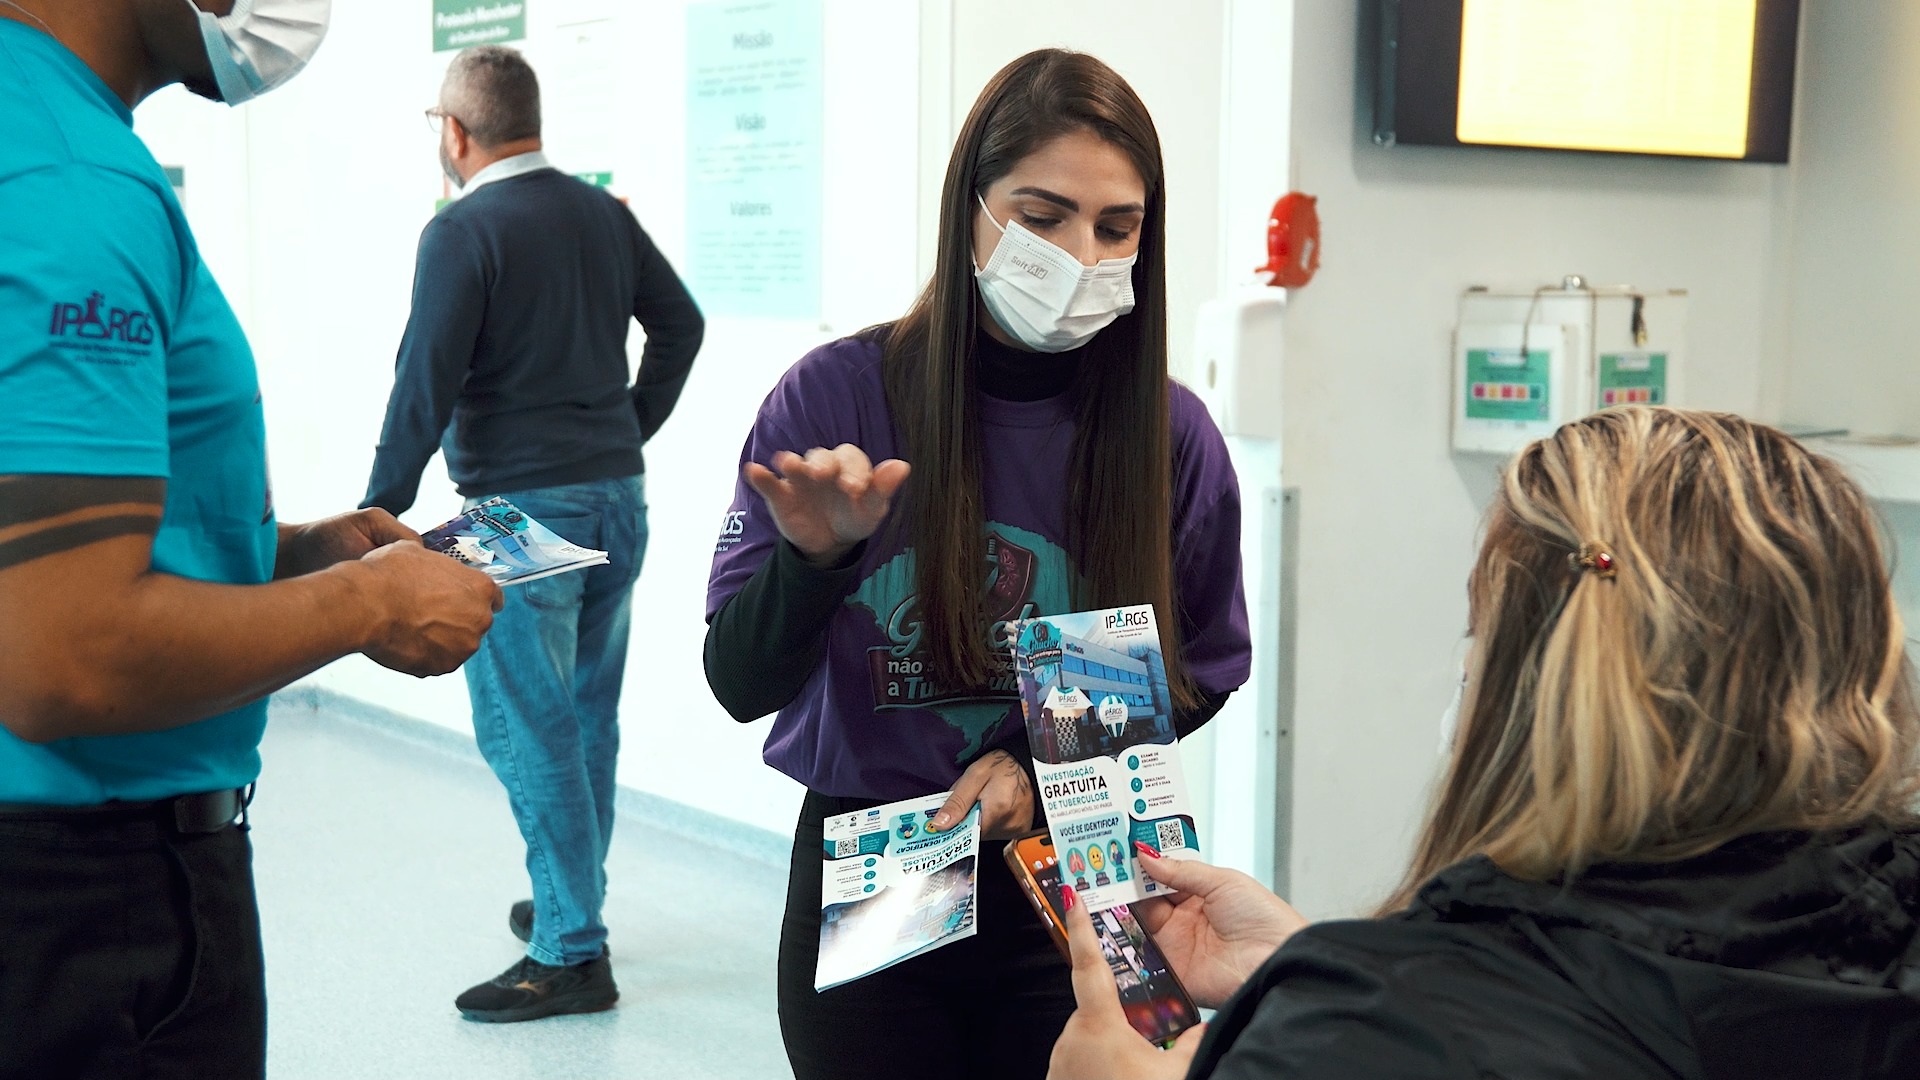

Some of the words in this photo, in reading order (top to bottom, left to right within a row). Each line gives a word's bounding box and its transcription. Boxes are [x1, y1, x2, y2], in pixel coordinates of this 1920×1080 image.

[732, 30, 774, 50] Missão
[735, 112, 766, 131] Visão
[730, 200, 773, 216] Valores
[888, 657, 923, 674] não
[887, 681, 900, 697] a
[1042, 765, 1095, 783] INVESTIGAÇÃO
[1044, 775, 1107, 799] GRATUITA
[1048, 802, 1058, 811] DE
[1058, 791, 1109, 808] TUBERCULOSE
[1084, 816, 1119, 832] IDENTIFICA?
[896, 840, 942, 854] IDENTIFICA?
[903, 839, 972, 875] GRATUITA
